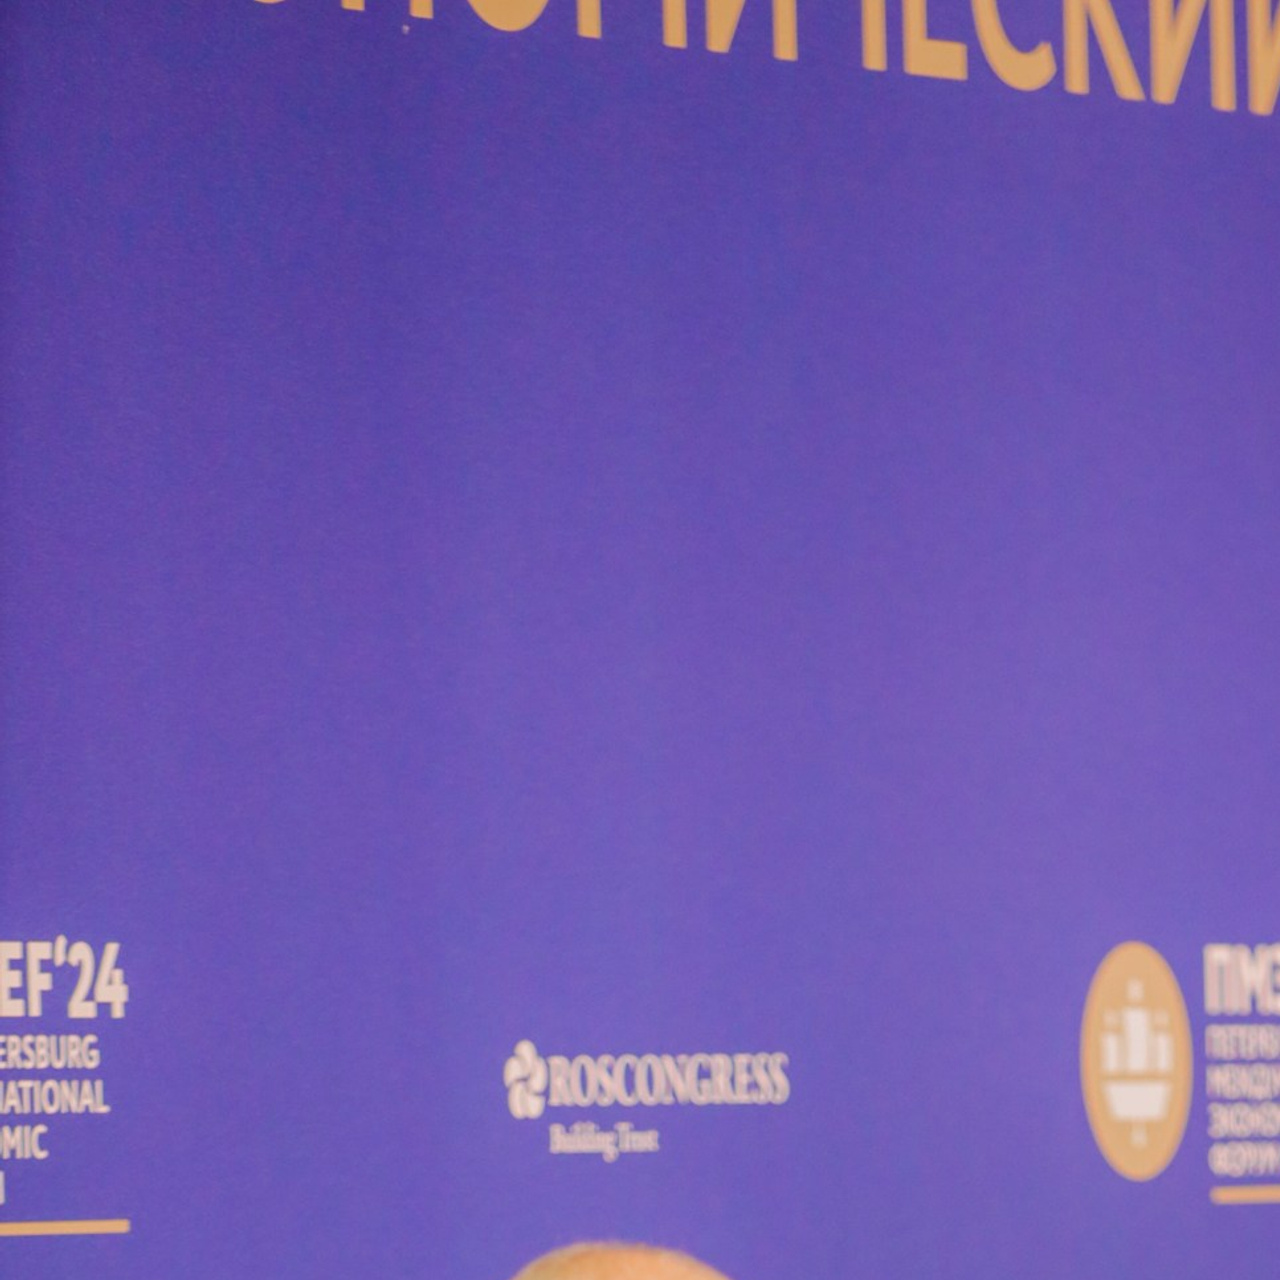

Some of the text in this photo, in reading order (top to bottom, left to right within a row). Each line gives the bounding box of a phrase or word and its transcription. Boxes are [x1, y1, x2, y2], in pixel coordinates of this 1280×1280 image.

[0, 1080, 111, 1114] ATIONAL
[548, 1051, 790, 1107] ROSCONGRESS
[0, 1124, 49, 1160] MIC
